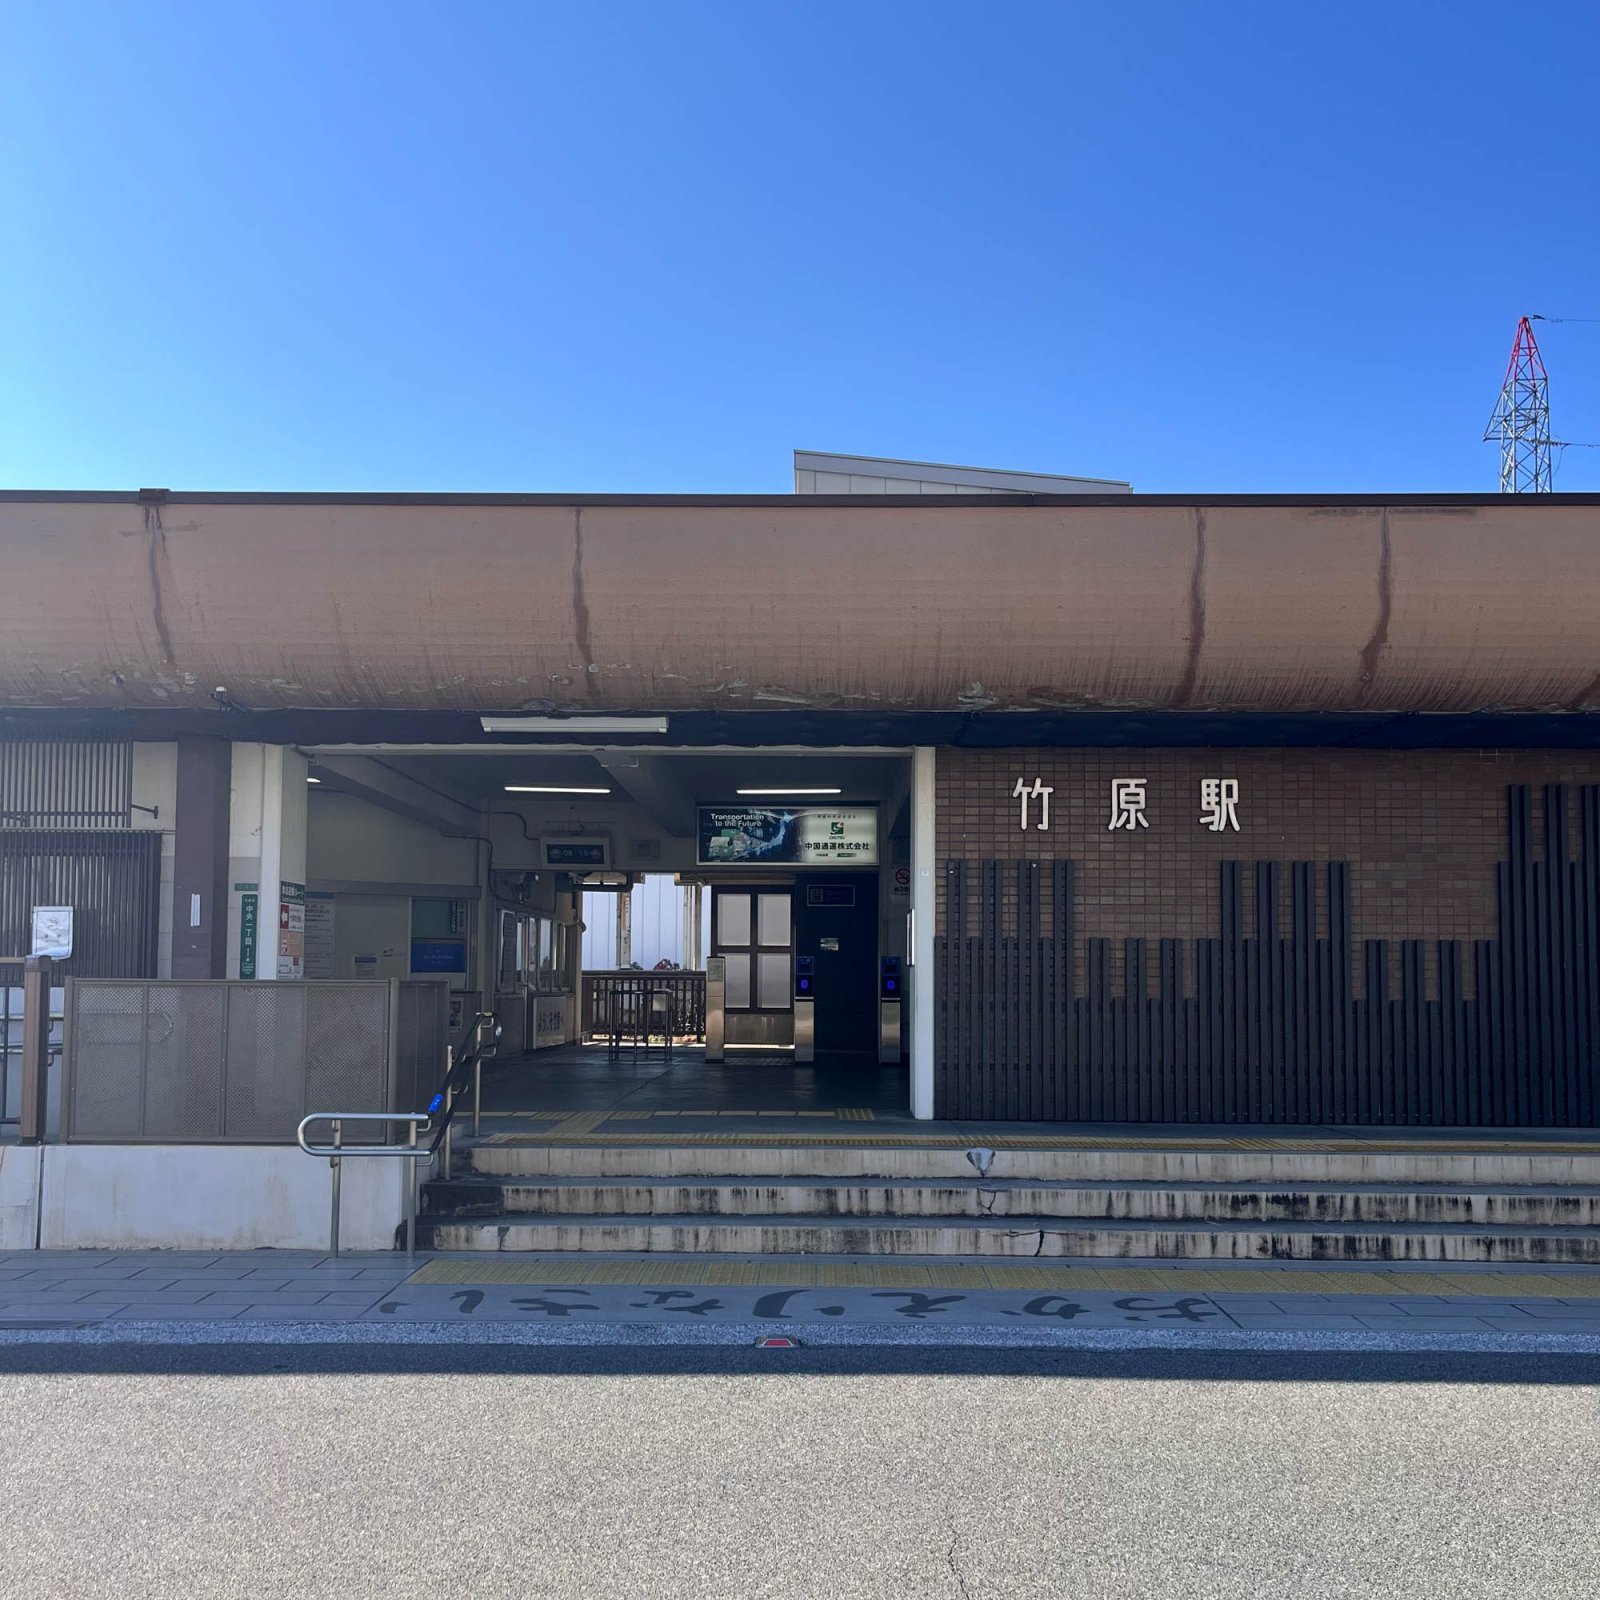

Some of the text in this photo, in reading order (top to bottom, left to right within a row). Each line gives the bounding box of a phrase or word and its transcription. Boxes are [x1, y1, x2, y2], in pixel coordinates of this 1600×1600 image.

[710, 813, 765, 821] Transportation
[1011, 776, 1241, 832] 竹原駅
[378, 1289, 1219, 1323] おかえりなさい
